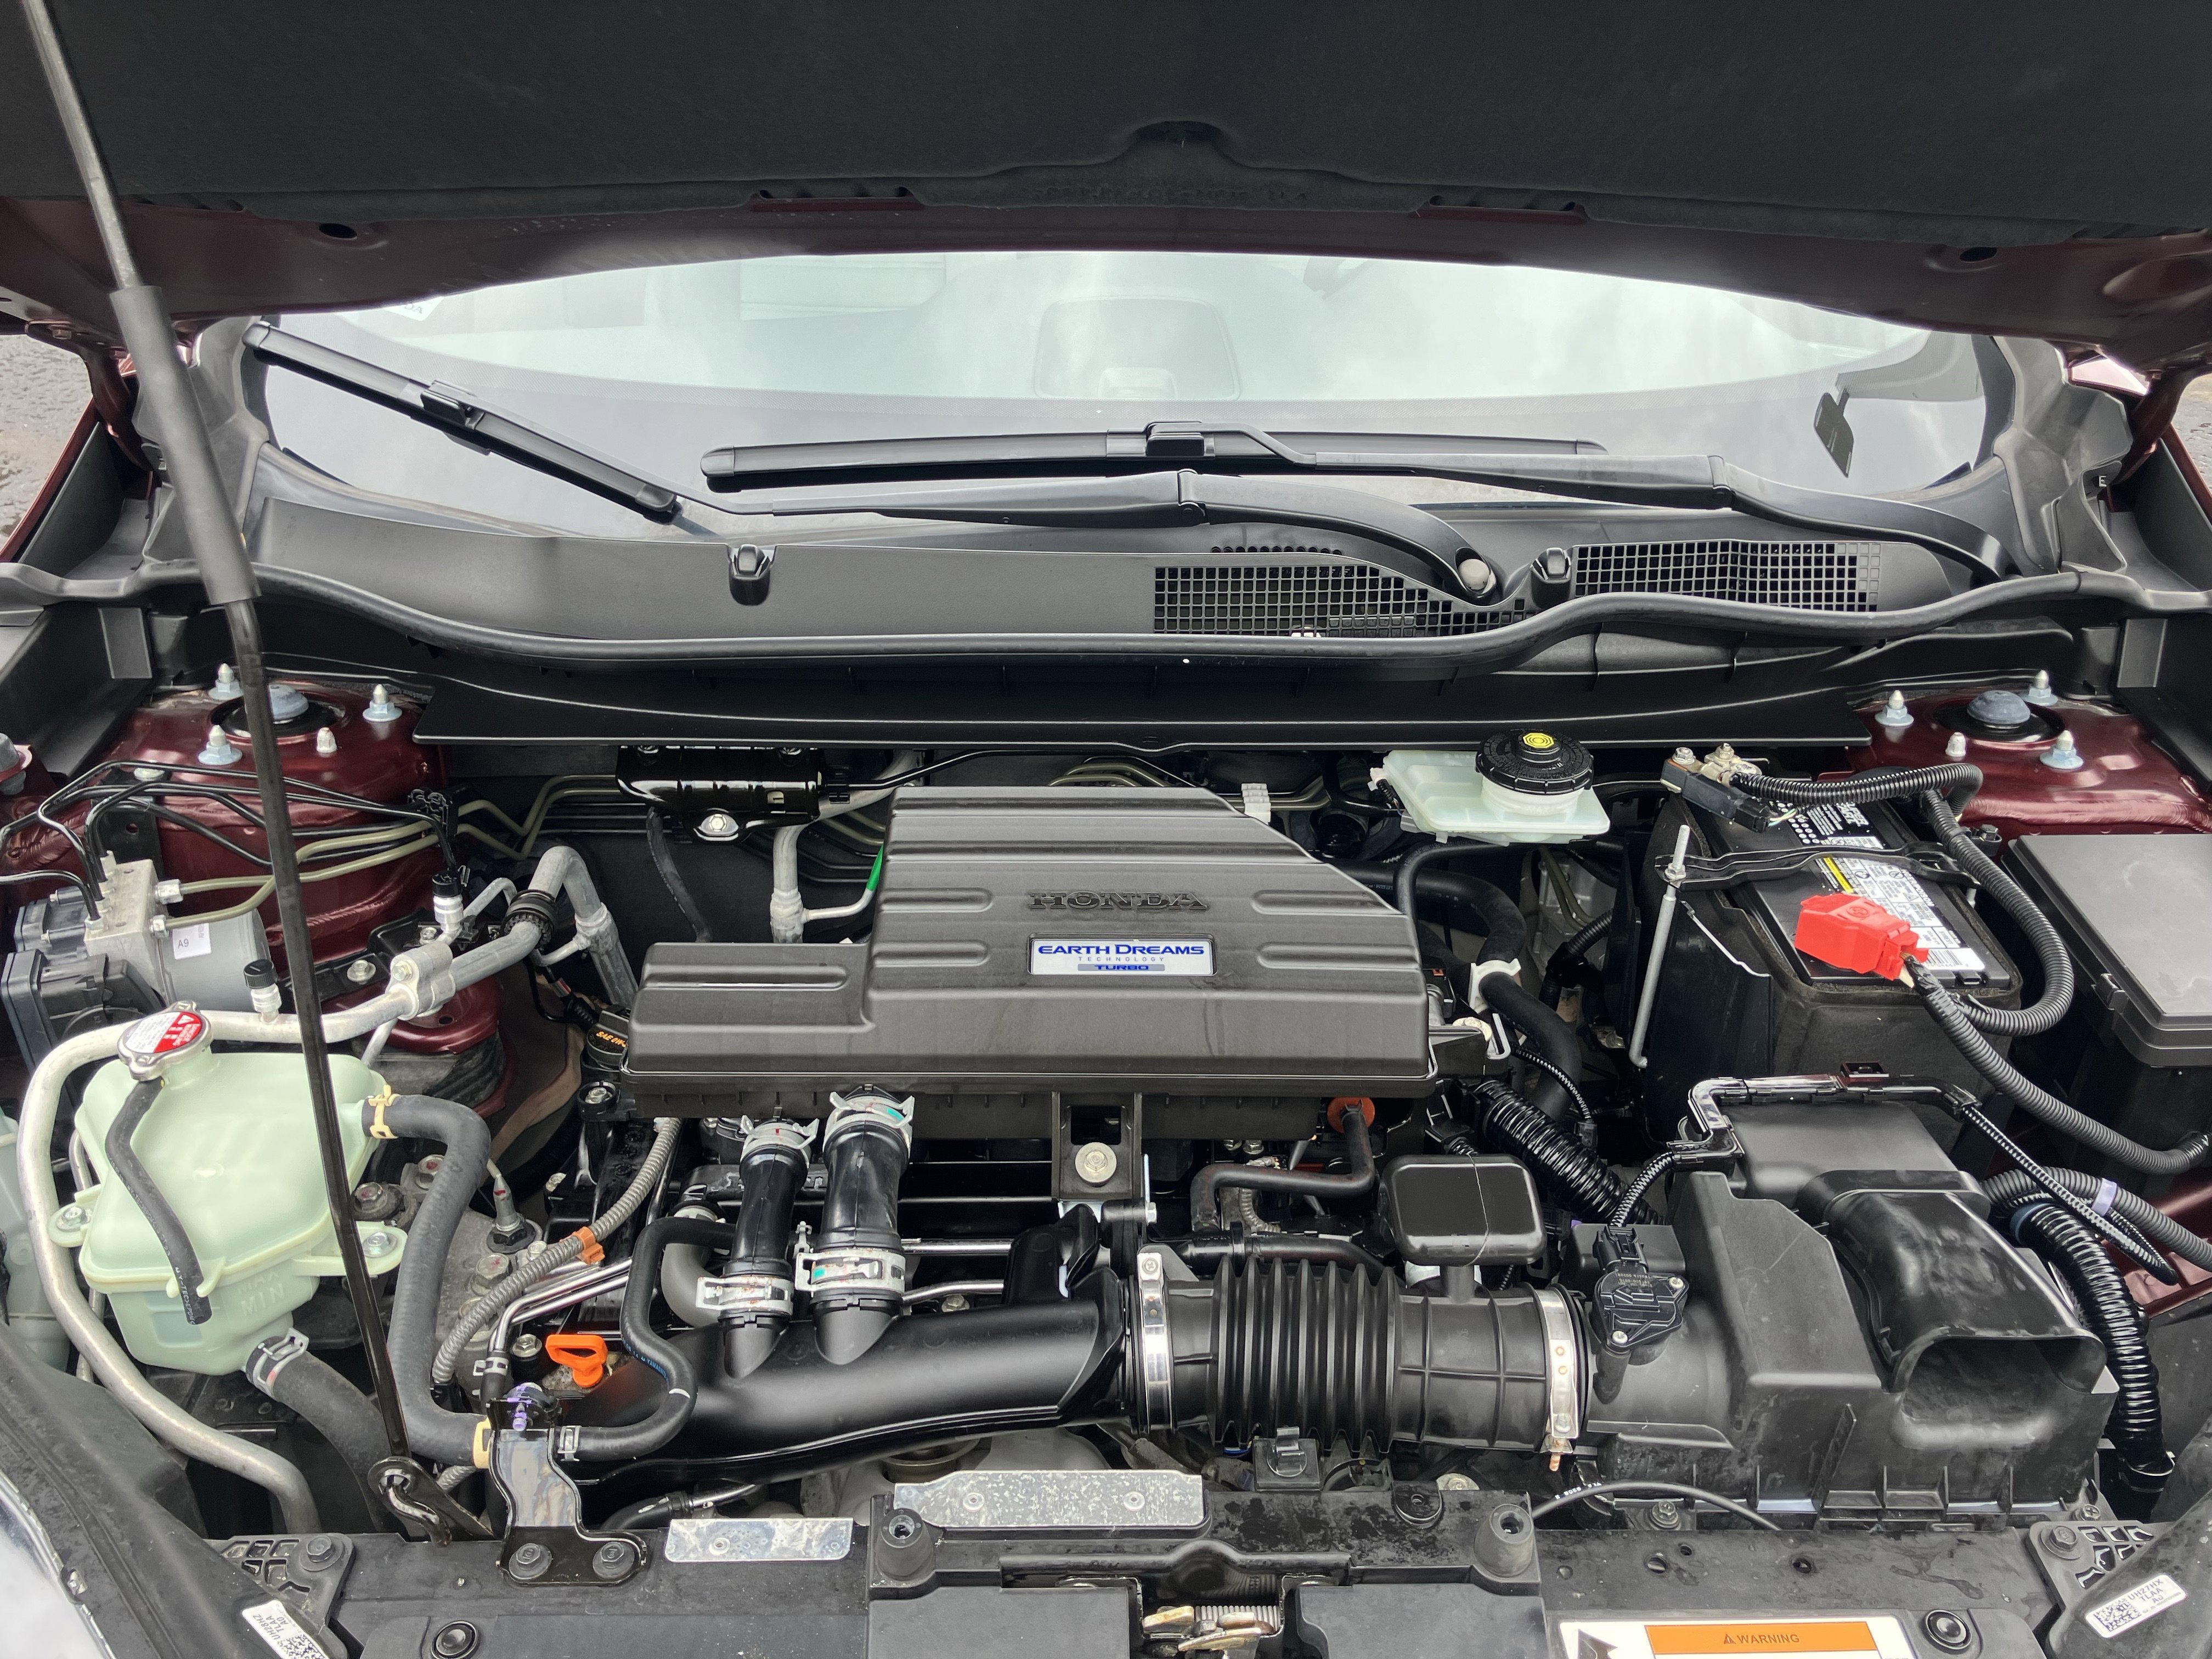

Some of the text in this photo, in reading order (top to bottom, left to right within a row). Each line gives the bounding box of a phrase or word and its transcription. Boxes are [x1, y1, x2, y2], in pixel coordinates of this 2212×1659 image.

[1901, 868, 1935, 907] NGER/POISON
[1029, 890, 1207, 911] HONDA
[178, 938, 189, 949] A9
[1038, 944, 1204, 955] EARTH DREAMS
[596, 1031, 614, 1041] SAE
[241, 1284, 284, 1316] MIN
[2128, 1579, 2164, 1600] UH27HX
[2139, 1588, 2163, 1601] TLAA
[253, 1614, 280, 1640] UH28HZ
[266, 1616, 284, 1632] TLAA
[276, 1617, 289, 1625] A0
[1737, 1633, 1800, 1645] WARNING
